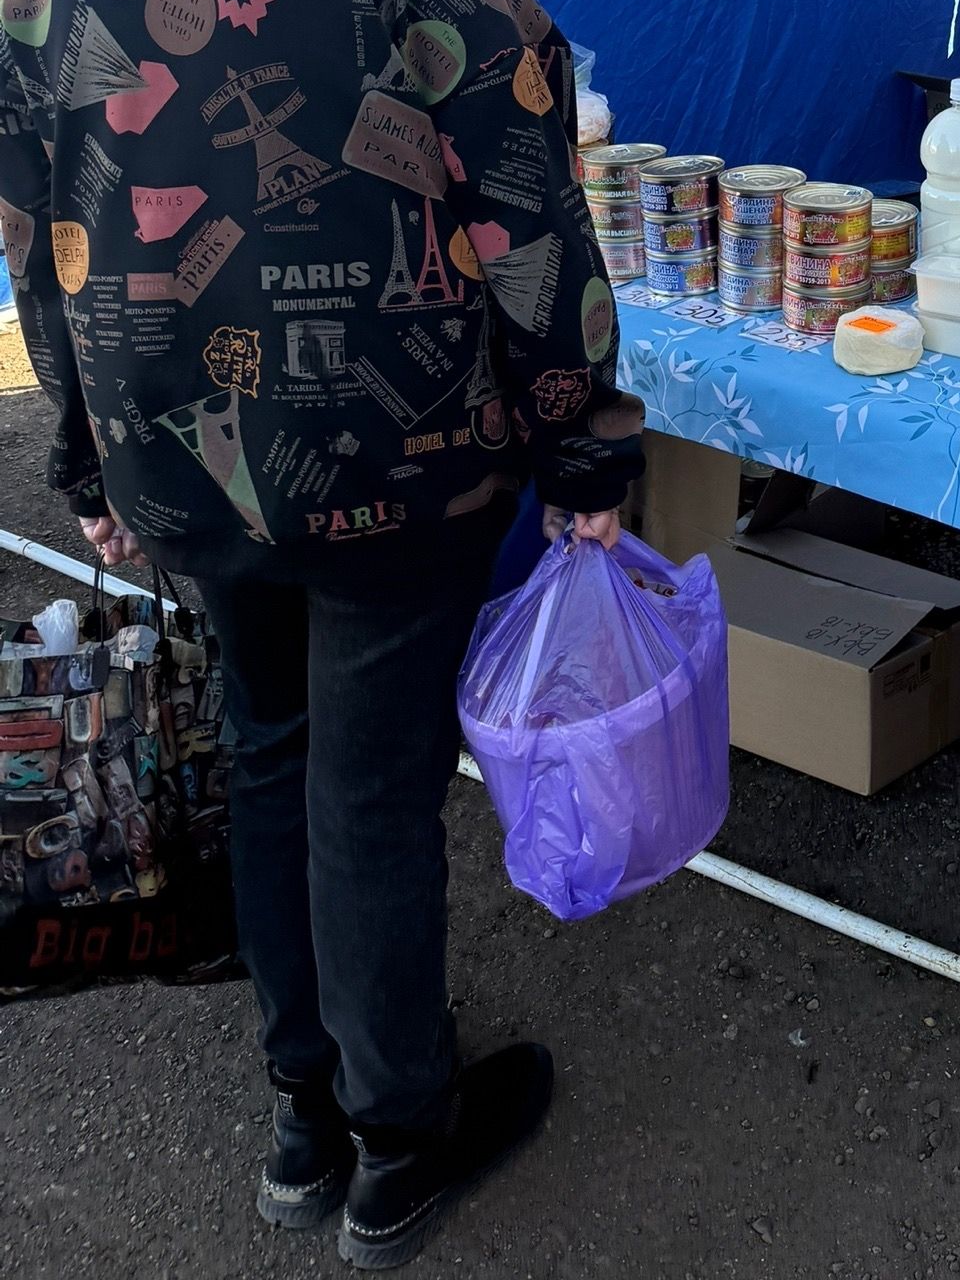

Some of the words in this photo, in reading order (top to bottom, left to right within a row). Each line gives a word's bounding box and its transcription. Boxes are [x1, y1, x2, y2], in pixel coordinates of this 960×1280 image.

[265, 163, 322, 201] PLAN
[135, 195, 183, 207] PARIS
[263, 222, 320, 233] Constitution
[182, 238, 225, 291] paris
[260, 261, 371, 291] PARIS
[272, 296, 356, 312] MONUMENTAL
[674, 304, 726, 325] 305
[401, 336, 440, 376] PARIS
[404, 431, 446, 456] HOTEL
[452, 427, 471, 447] DE
[304, 500, 408, 534] PARIS
[28, 916, 113, 967] Big
